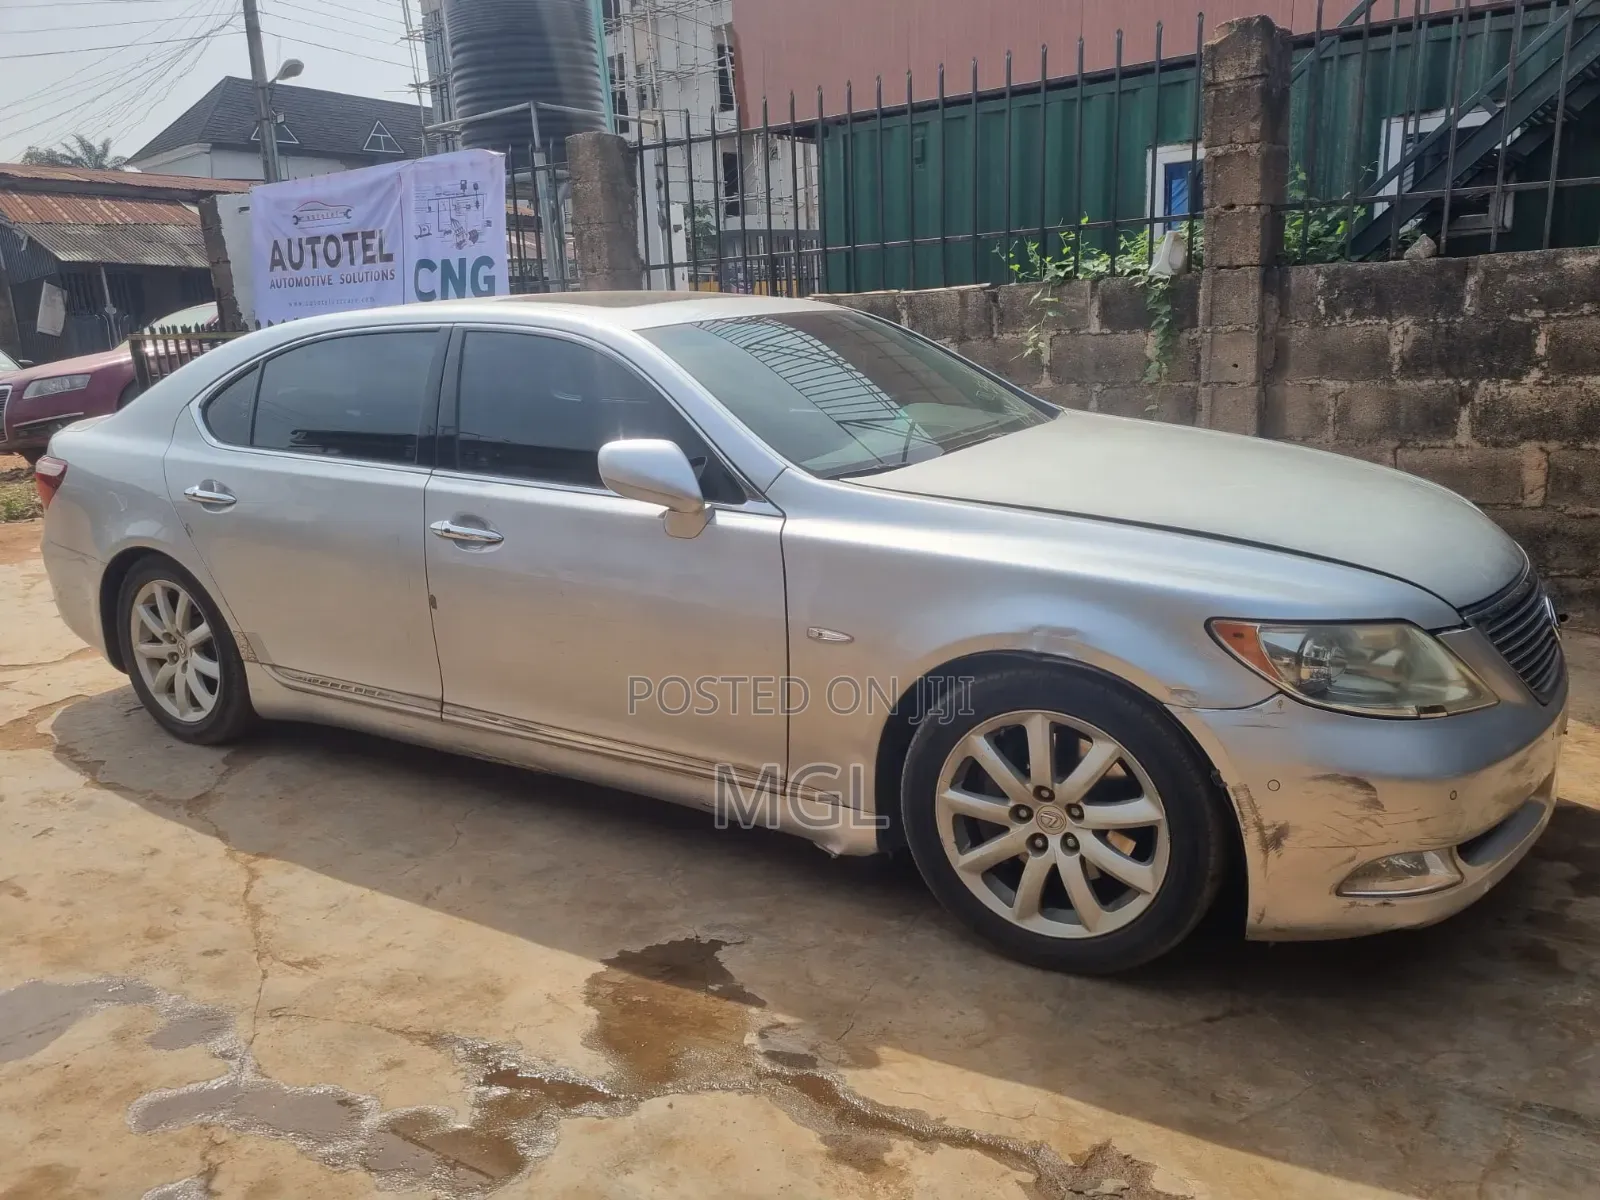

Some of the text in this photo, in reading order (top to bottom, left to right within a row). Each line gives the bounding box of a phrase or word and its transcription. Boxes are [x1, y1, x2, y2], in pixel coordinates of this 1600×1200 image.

[269, 229, 394, 272] AUTOTEL
[269, 269, 396, 290] AUTOMOTIVE SOLUTIONS
[414, 255, 496, 302] CNG
